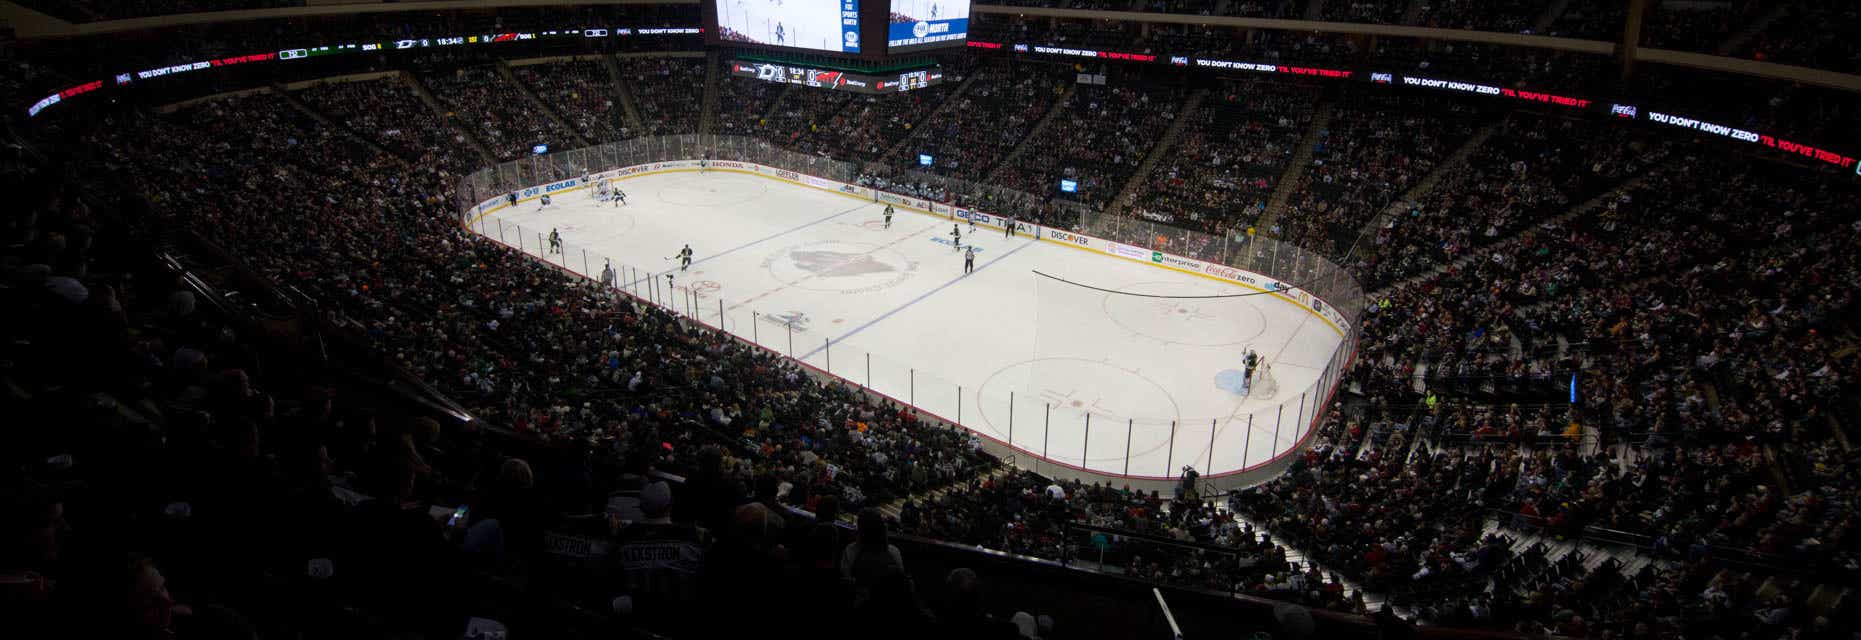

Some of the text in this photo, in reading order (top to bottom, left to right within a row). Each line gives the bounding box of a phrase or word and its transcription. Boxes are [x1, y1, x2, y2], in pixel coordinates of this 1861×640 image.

[1211, 60, 1232, 68] DON'T
[1256, 64, 1276, 72] ZERO
[138, 71, 151, 79] YOU
[1403, 76, 1421, 85] YOU
[1421, 78, 1448, 88] DON'T
[1448, 81, 1476, 92] KNOW
[1476, 85, 1500, 95] ZERO
[1649, 112, 1668, 123] YOU
[1669, 116, 1700, 129] DON'T
[1700, 121, 1731, 136] KNOW
[1731, 128, 1760, 142] ZERO
[1778, 140, 1814, 157] YOU'VE
[1815, 148, 1841, 164] TRIED
[618, 166, 648, 176] DISCOVER
[546, 180, 576, 192] ECOLAB
[956, 210, 990, 223] GECO
[1051, 230, 1089, 246] DISCOVER
[1236, 274, 1256, 284] zero
